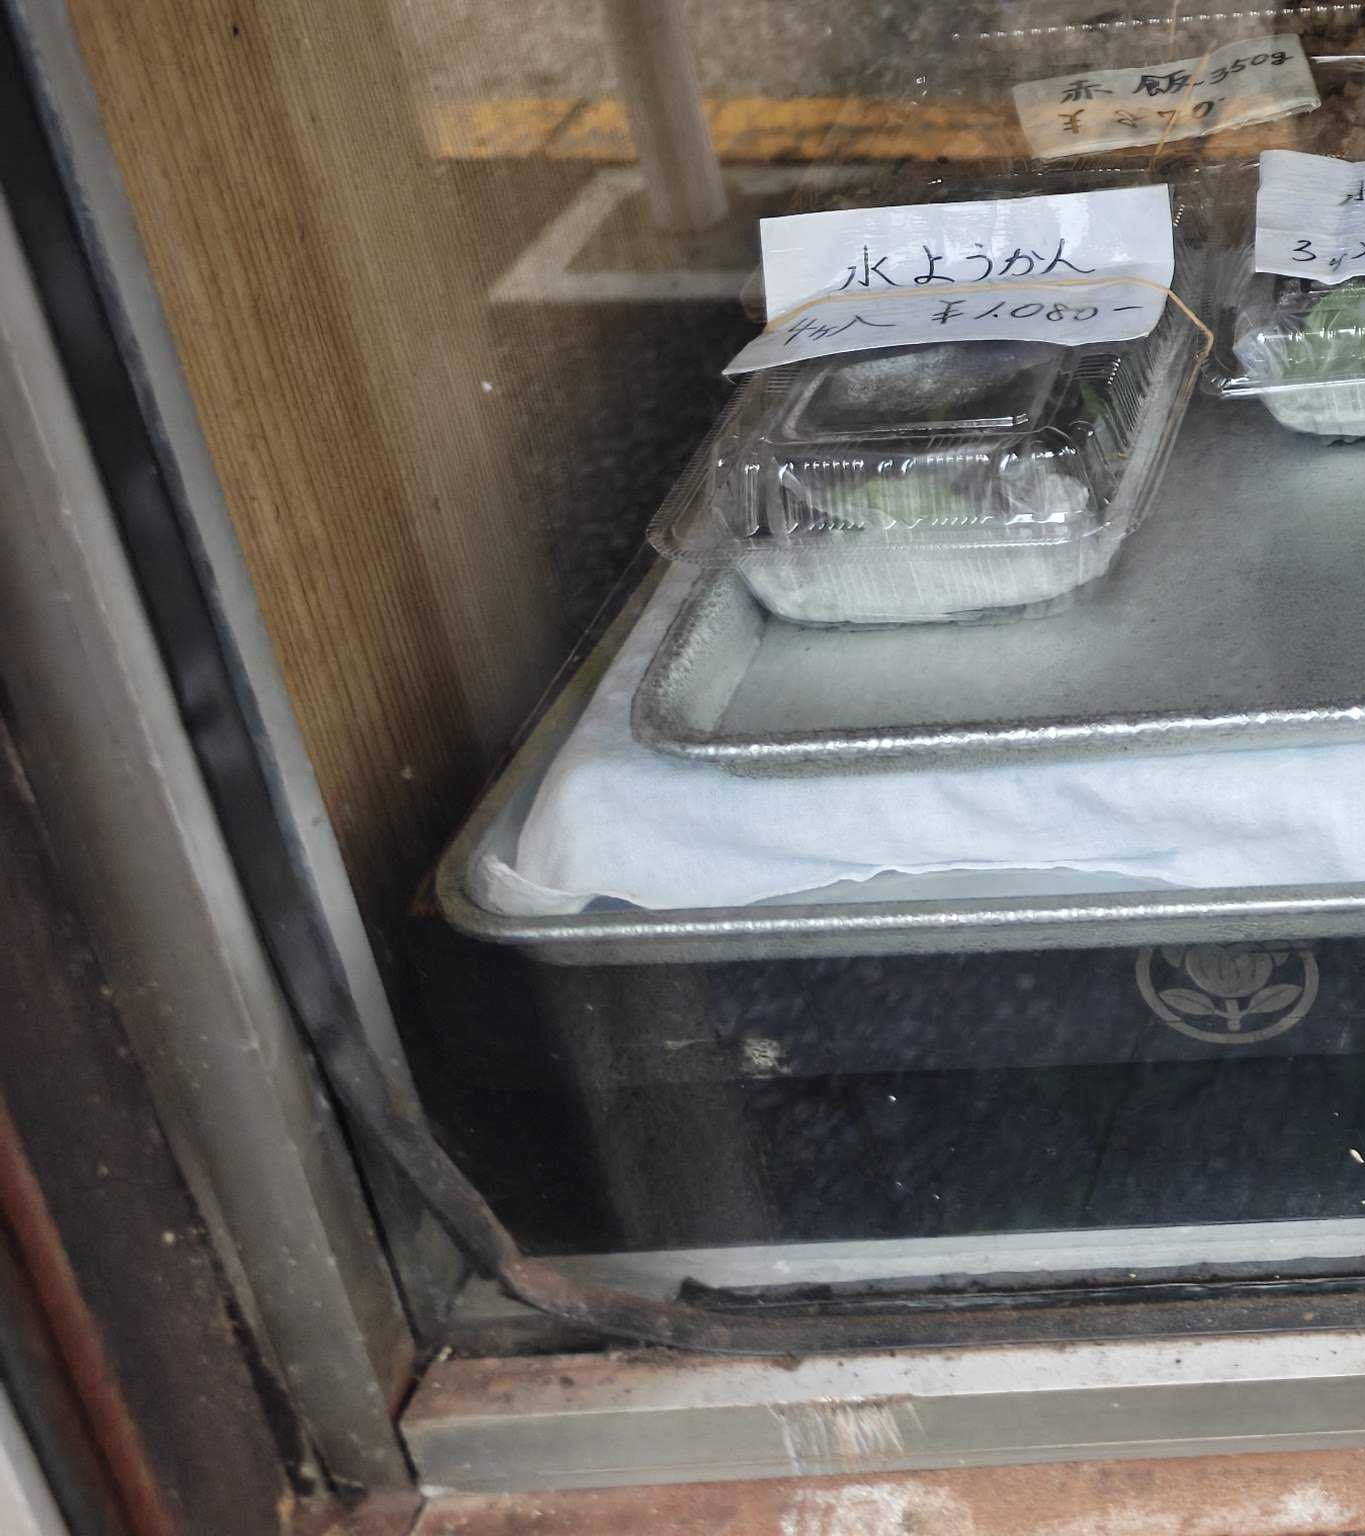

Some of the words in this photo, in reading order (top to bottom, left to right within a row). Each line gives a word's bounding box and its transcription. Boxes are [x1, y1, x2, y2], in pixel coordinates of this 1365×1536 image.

[838, 237, 1096, 292] 水ようかん
